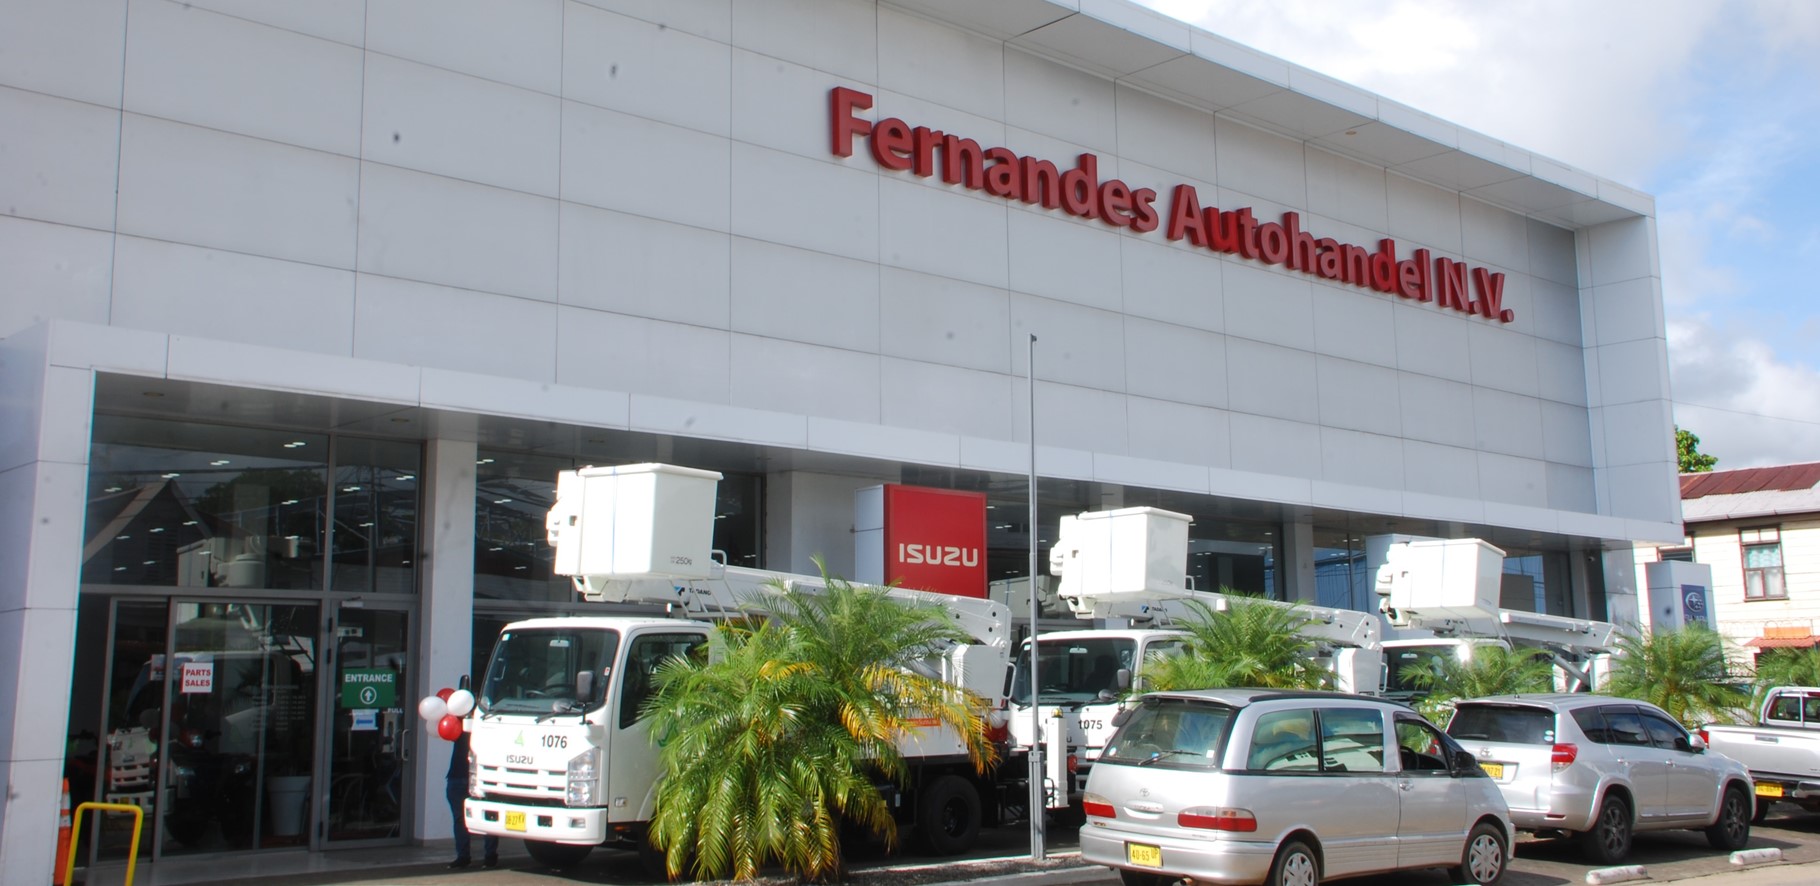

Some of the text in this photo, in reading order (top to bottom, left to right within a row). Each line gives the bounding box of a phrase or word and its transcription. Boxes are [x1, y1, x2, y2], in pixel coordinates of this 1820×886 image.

[830, 86, 1515, 322] Fernandes Autohandel N.V.
[899, 543, 978, 567] ISUZU
[185, 679, 210, 687] SALES
[345, 673, 393, 683] ENTRANCE
[1078, 719, 1103, 730] 1075
[542, 734, 567, 749] 1076
[506, 754, 534, 765] ISUZU
